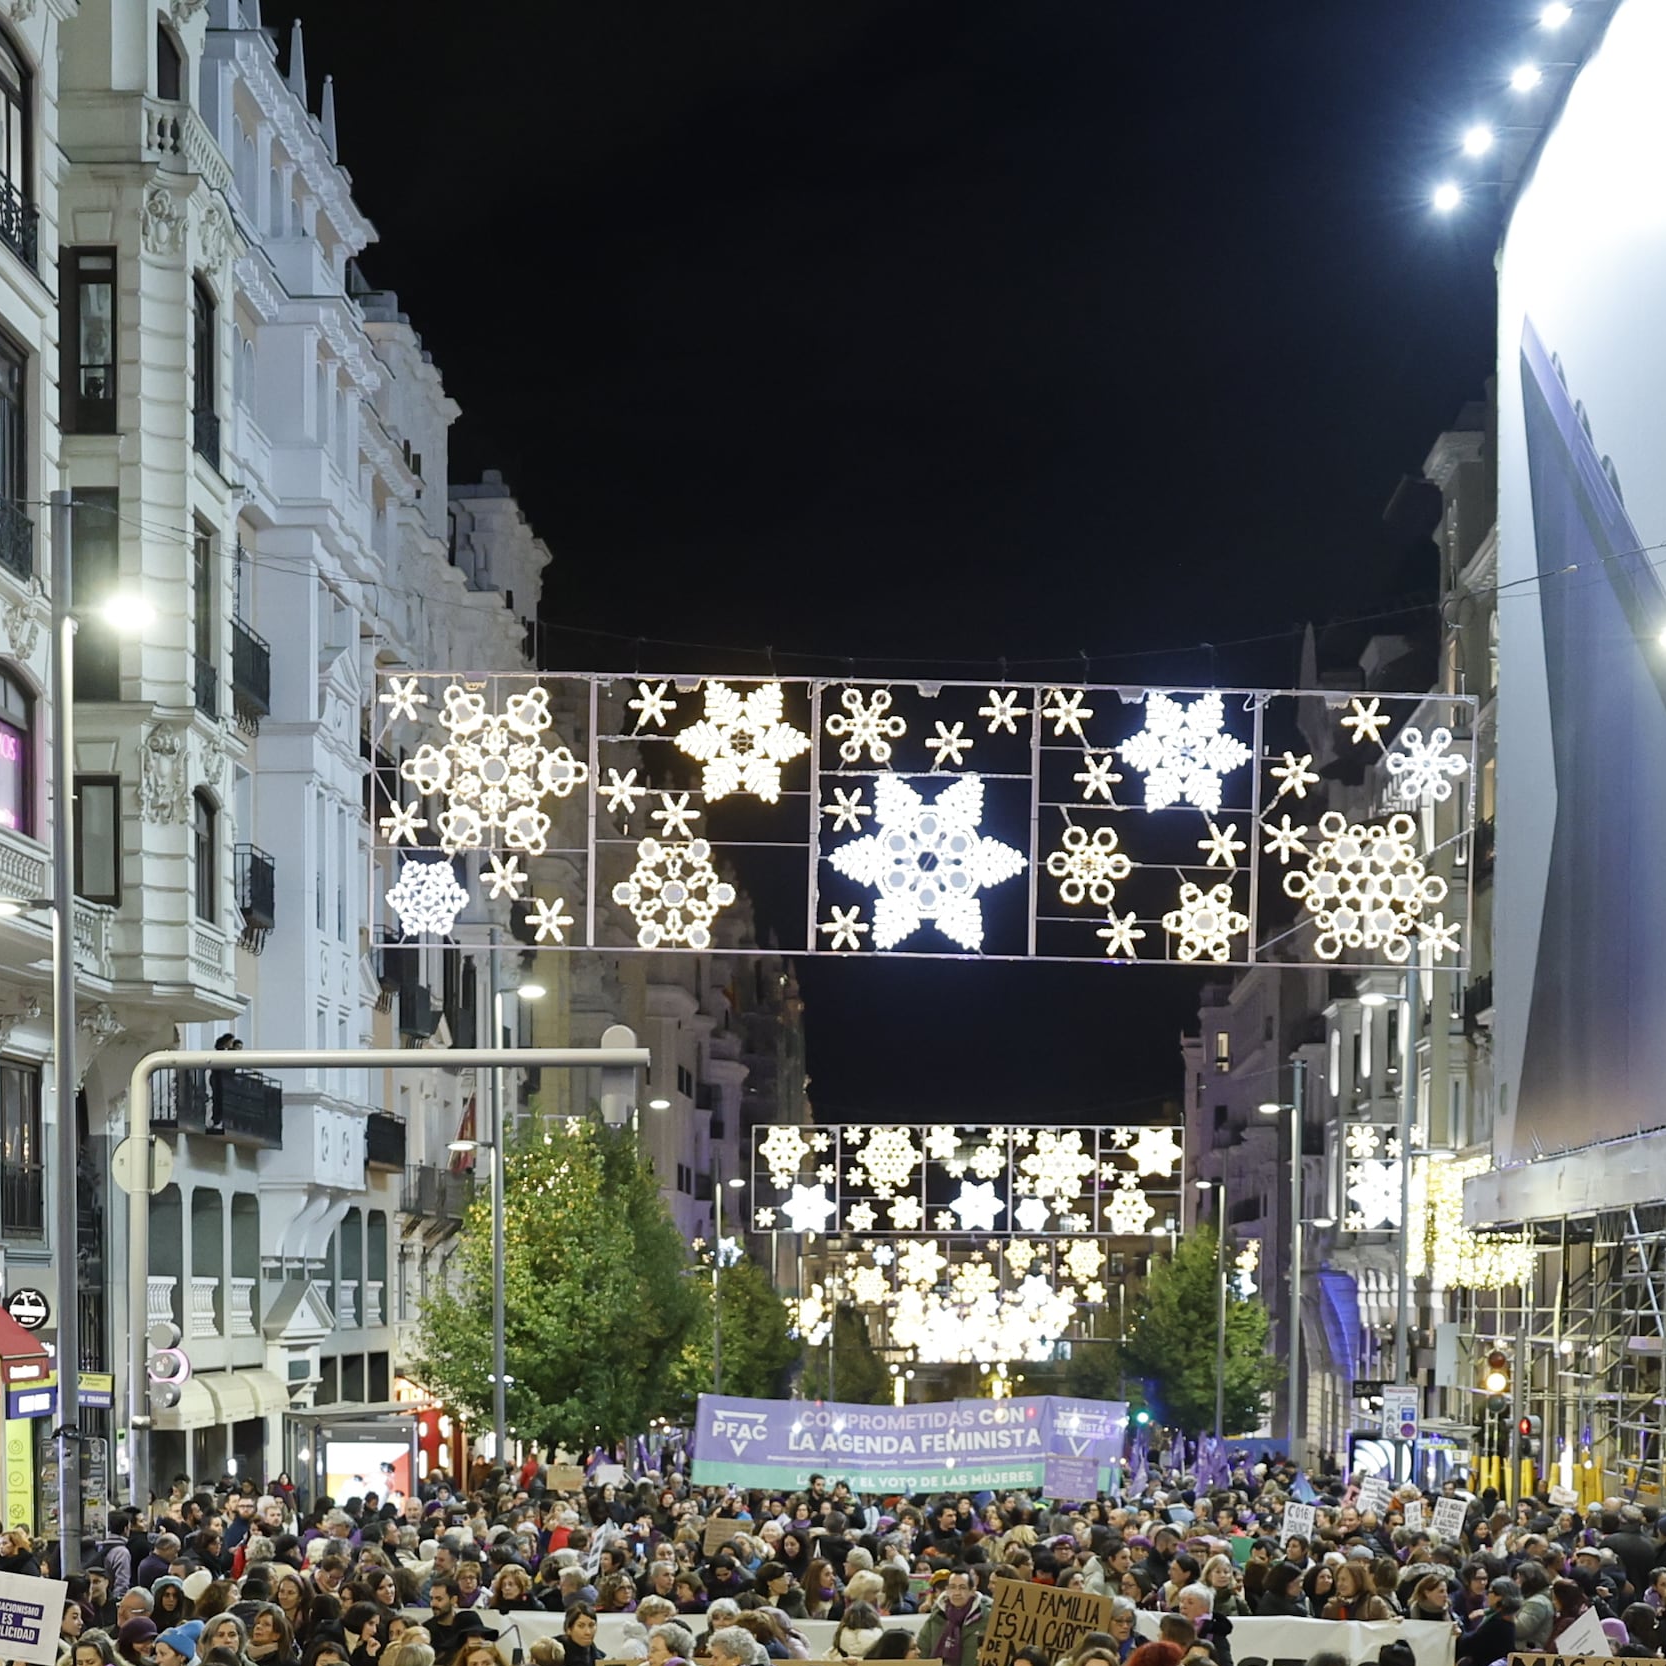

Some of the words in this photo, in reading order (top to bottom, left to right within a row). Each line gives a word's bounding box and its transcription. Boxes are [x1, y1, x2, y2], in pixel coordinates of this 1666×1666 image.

[801, 1410, 975, 1431] COMPROMETIDAS
[979, 1406, 1025, 1426] CON
[712, 1420, 767, 1441] PFAC
[789, 1432, 815, 1450] LA
[821, 1432, 916, 1454] AGENDA
[921, 1427, 1042, 1453] FEMINISTA
[860, 1476, 876, 1488] EL
[883, 1477, 917, 1488] VOTO
[921, 1475, 939, 1486] DE
[942, 1474, 968, 1486] LAS
[970, 1470, 1034, 1486] MUJERES
[998, 1585, 1025, 1612] LA
[1036, 1591, 1100, 1625] FAMILIA
[1, 1612, 14, 1626] ES
[994, 1611, 1017, 1640] ES
[1019, 1615, 1036, 1646] LA
[987, 1639, 1002, 1653] DE
